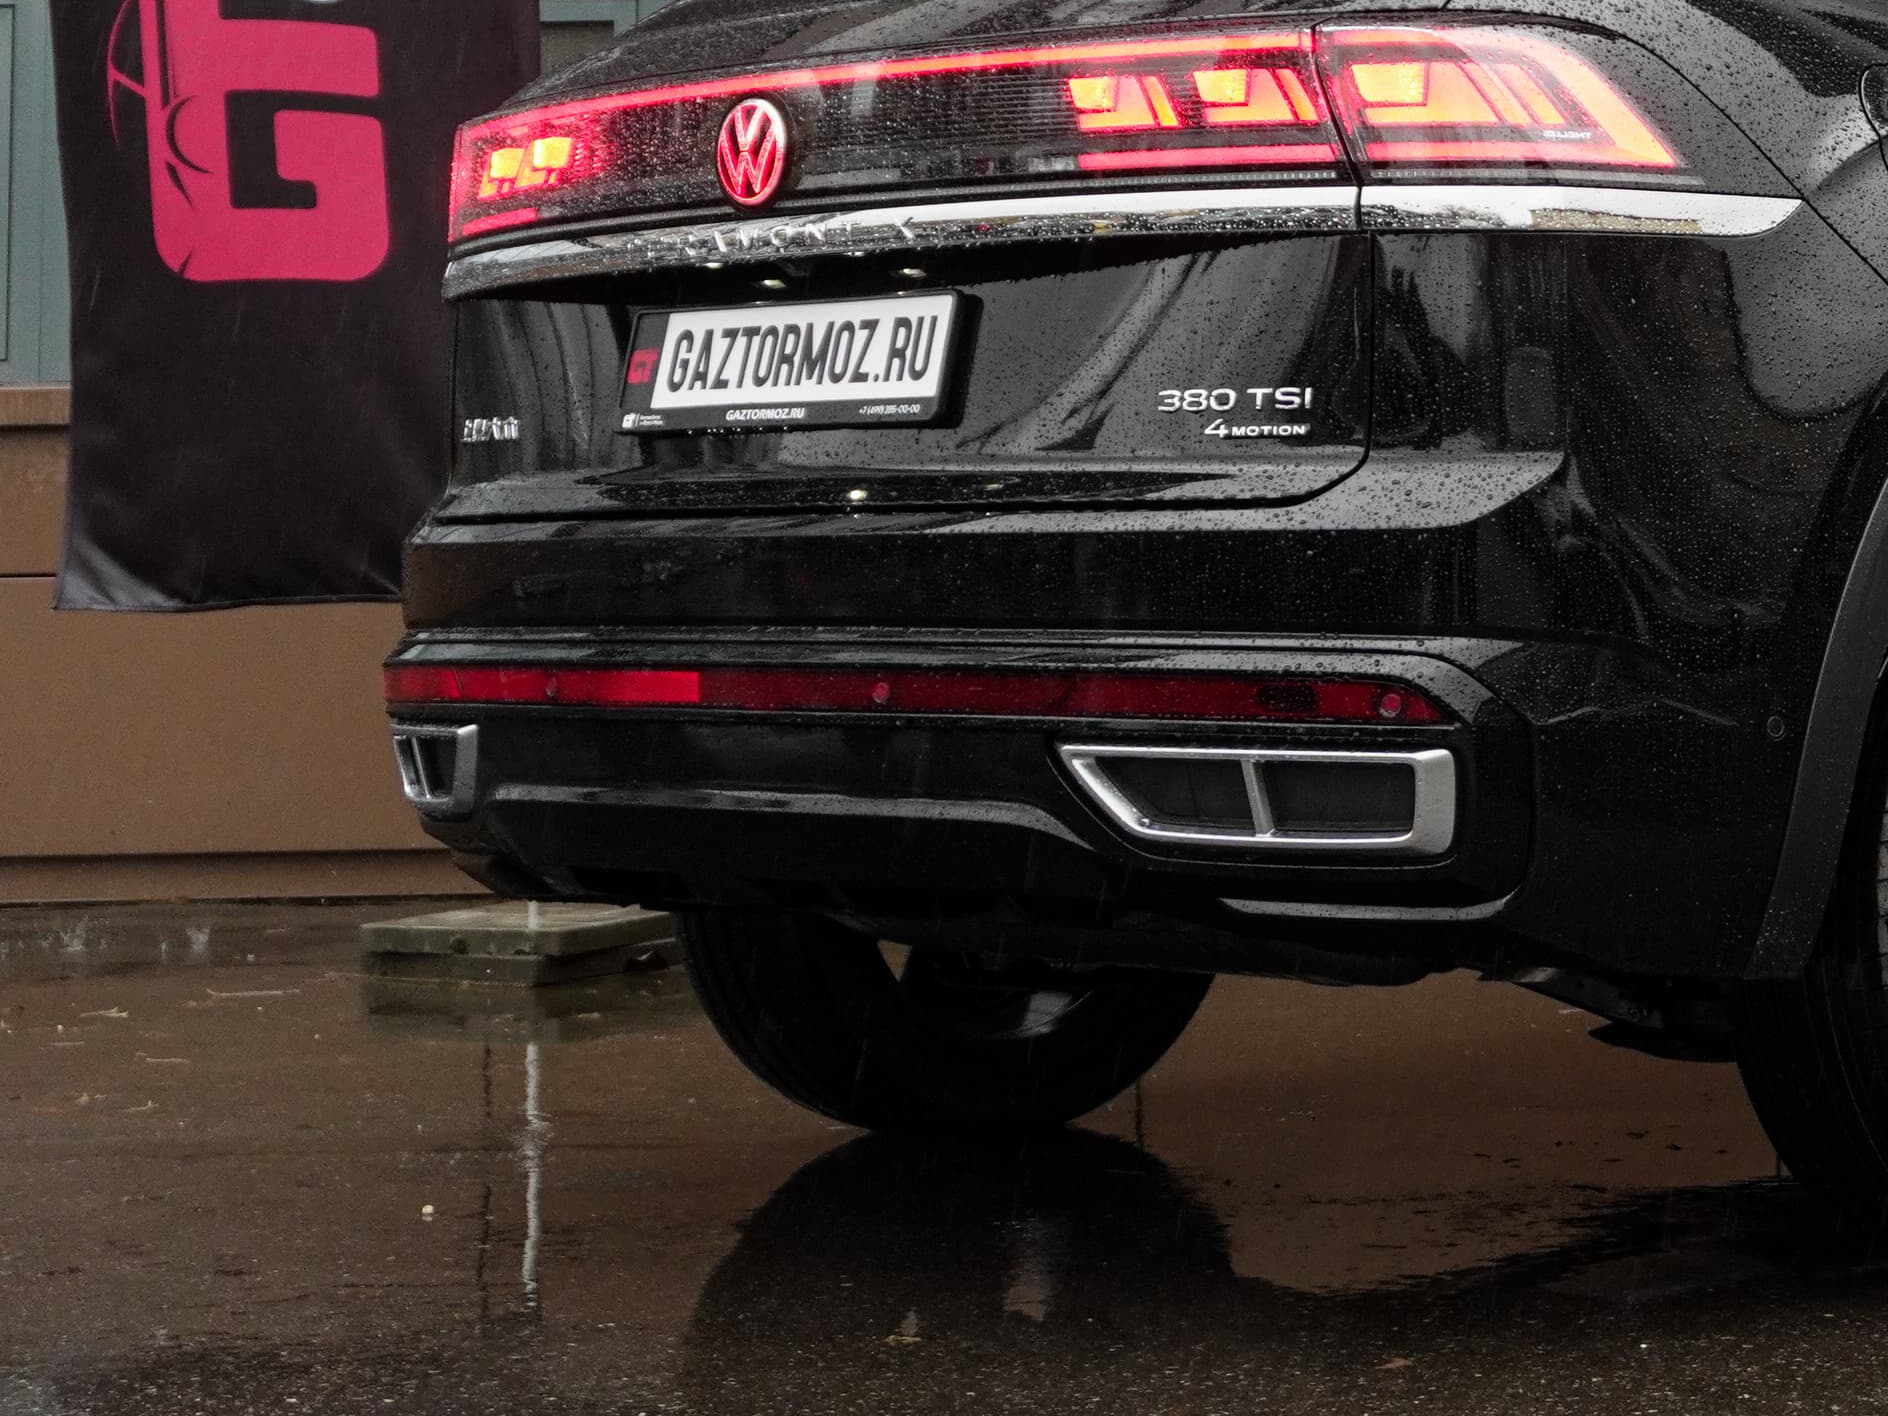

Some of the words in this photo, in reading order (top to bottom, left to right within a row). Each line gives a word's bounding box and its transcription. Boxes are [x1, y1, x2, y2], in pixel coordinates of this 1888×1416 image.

[717, 98, 786, 205] VW
[666, 315, 938, 393] GAZTORMOZ.RU
[1157, 388, 1237, 412] 380
[1246, 387, 1313, 410] TSI
[725, 407, 805, 421] GAZTORMOZ.RU
[1204, 418, 1307, 438] 4MOTION
